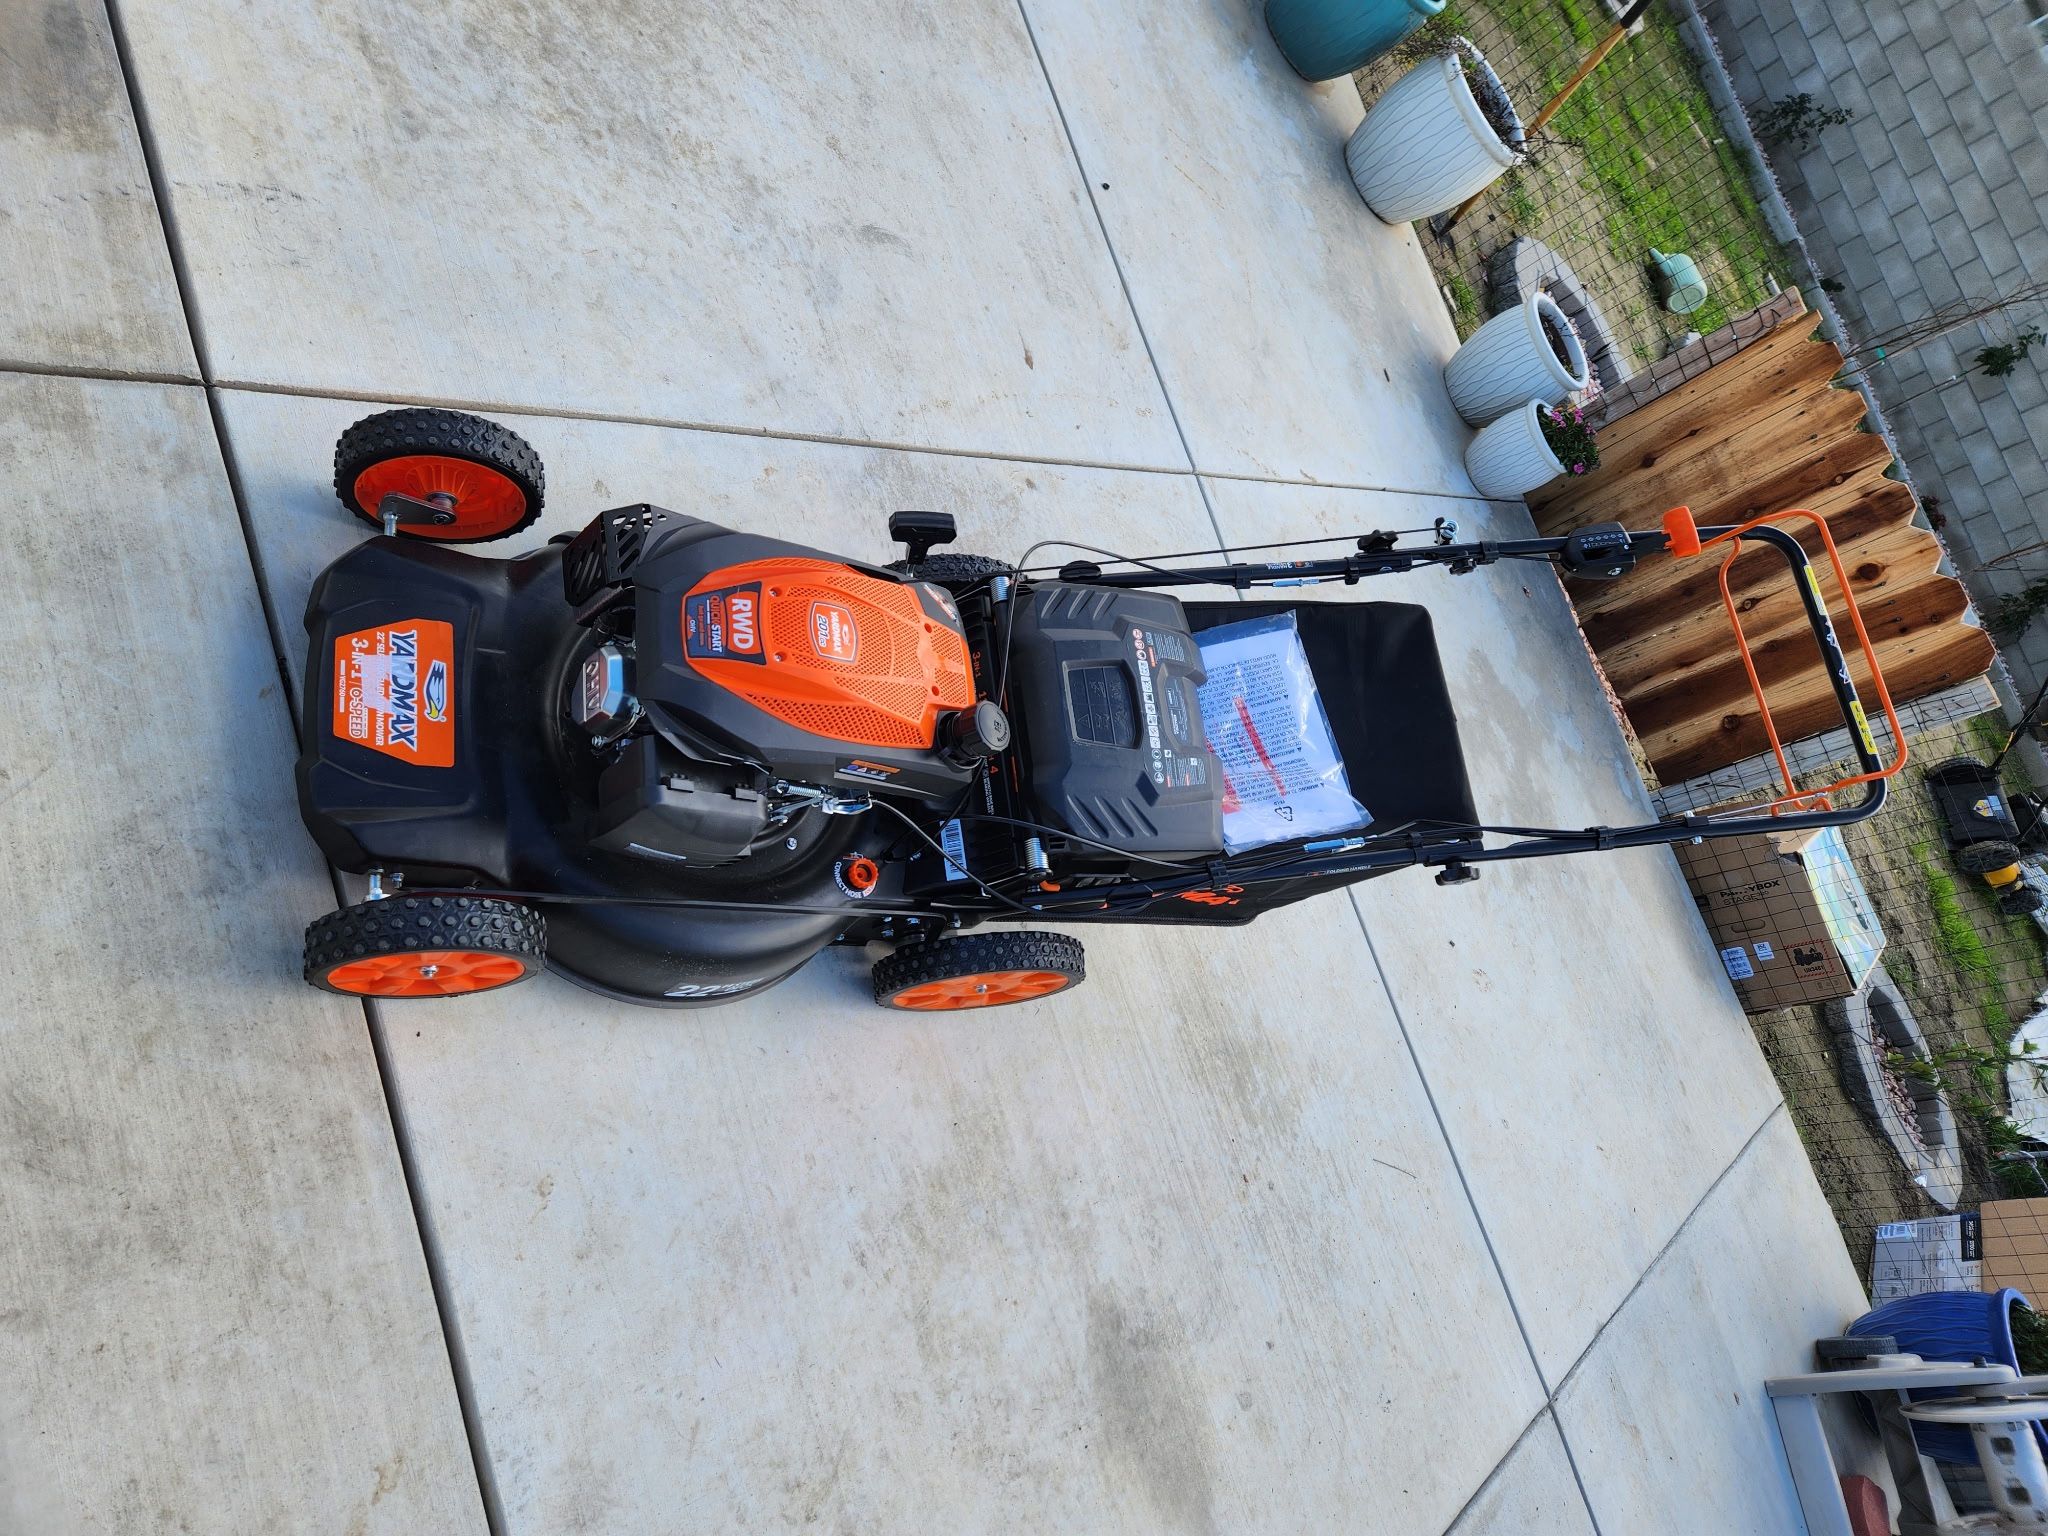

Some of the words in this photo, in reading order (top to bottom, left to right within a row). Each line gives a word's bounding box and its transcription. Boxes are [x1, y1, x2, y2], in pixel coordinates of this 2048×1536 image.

[729, 597, 755, 649] RWD
[830, 611, 843, 653] YARDMAX
[375, 718, 384, 745] MOWER
[971, 651, 983, 678] 3-IN-1
[989, 765, 999, 773] 4
[834, 861, 846, 890] CONNECT
[845, 889, 862, 898] HOSE
[663, 982, 721, 999] 22
